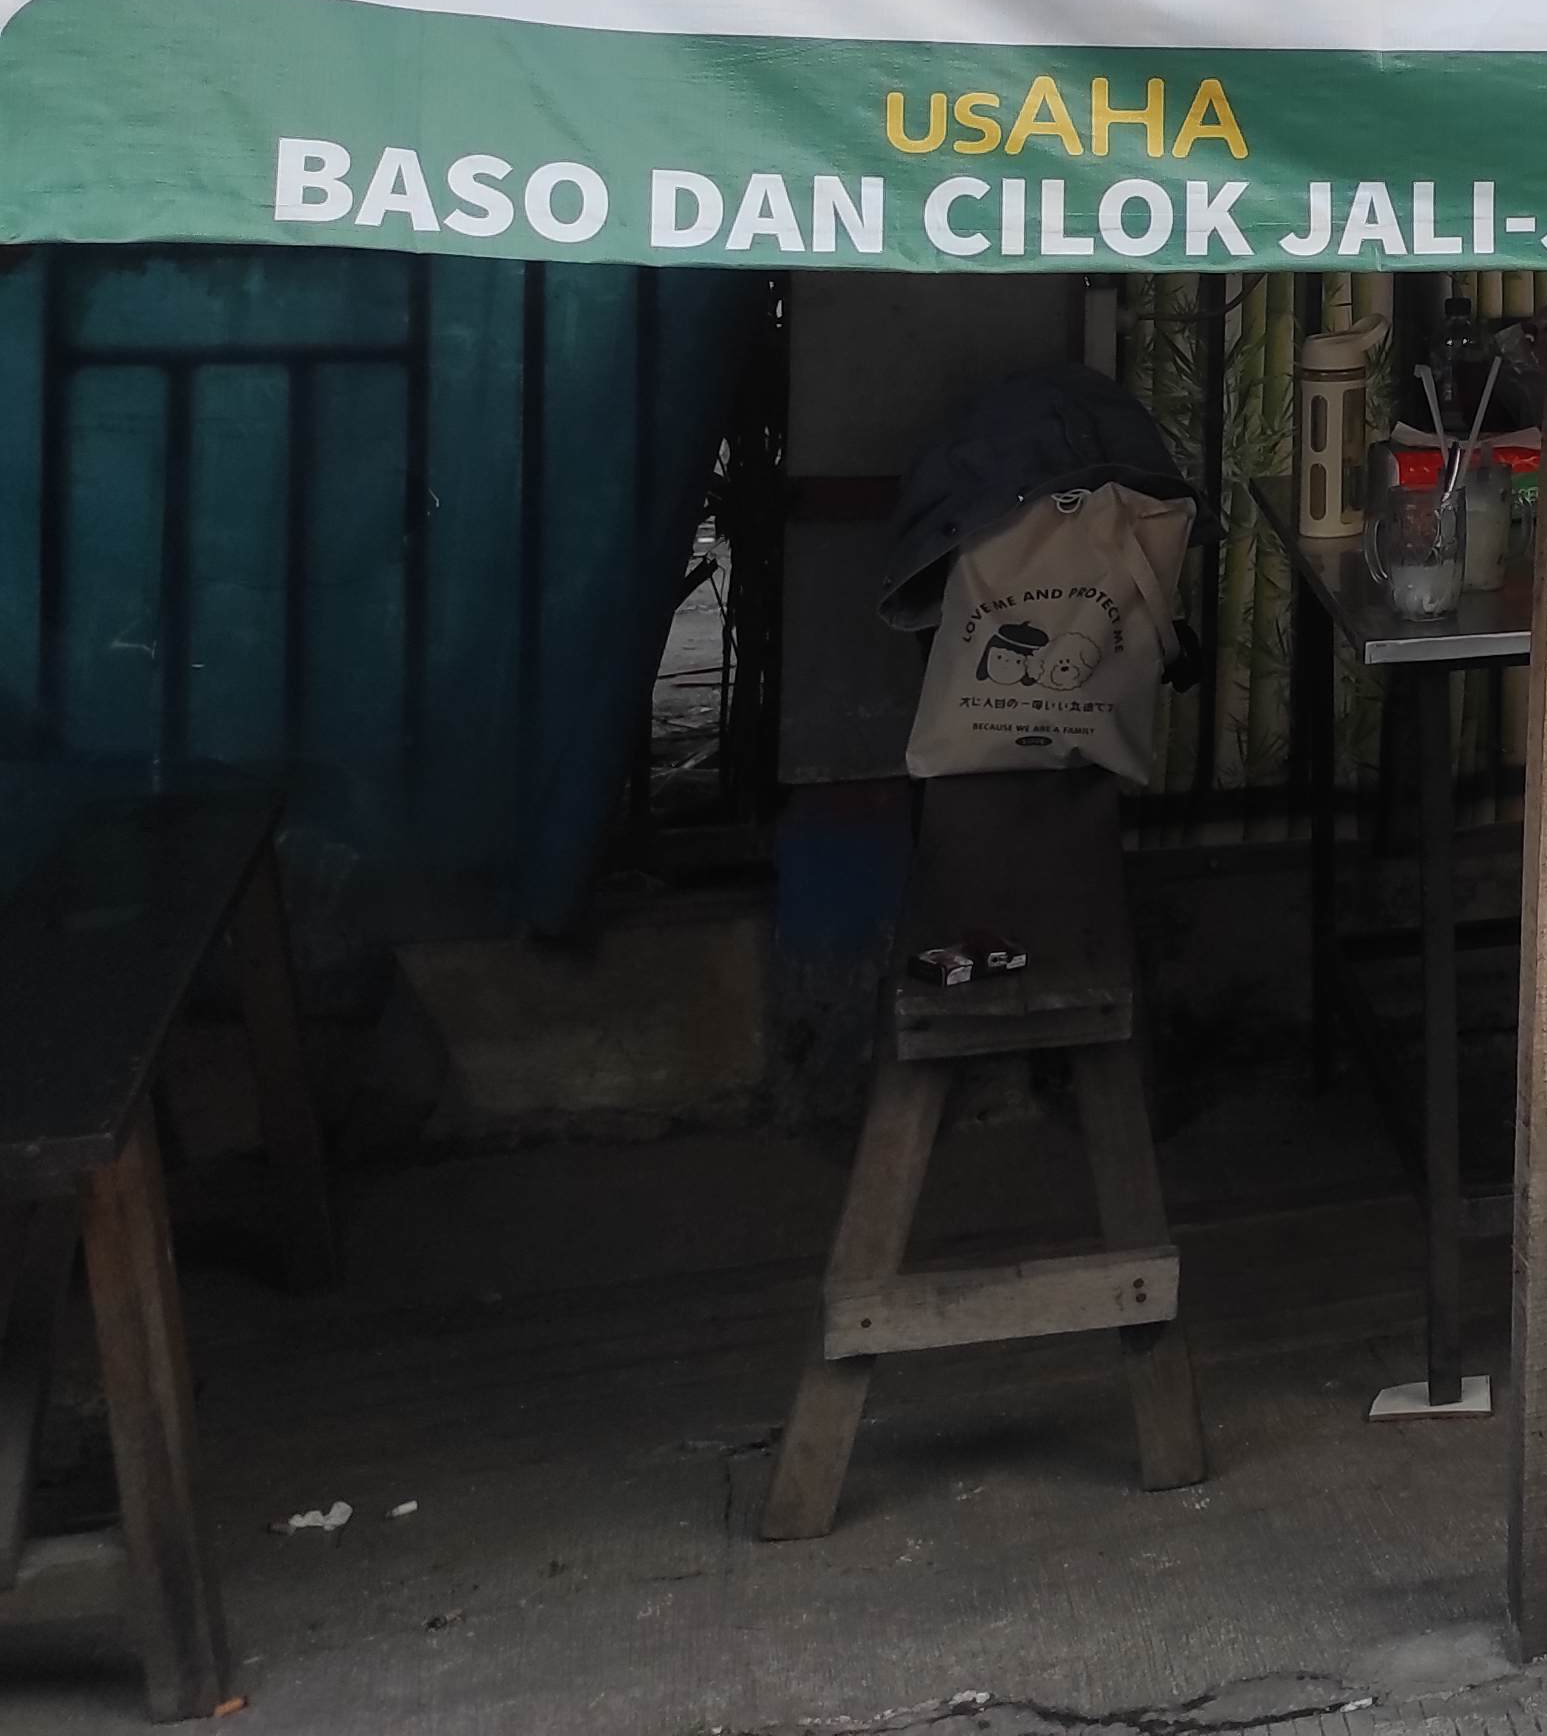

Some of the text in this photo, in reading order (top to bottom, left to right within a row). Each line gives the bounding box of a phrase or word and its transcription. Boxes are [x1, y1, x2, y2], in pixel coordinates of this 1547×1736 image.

[273, 136, 611, 245] BASO
[648, 168, 885, 255] DAN
[922, 176, 1256, 259] CILOK
[961, 586, 1125, 654] LOVE ME AND PROTECT ME
[972, 721, 1097, 736] BECAUSE WE ARE A FAMILY
